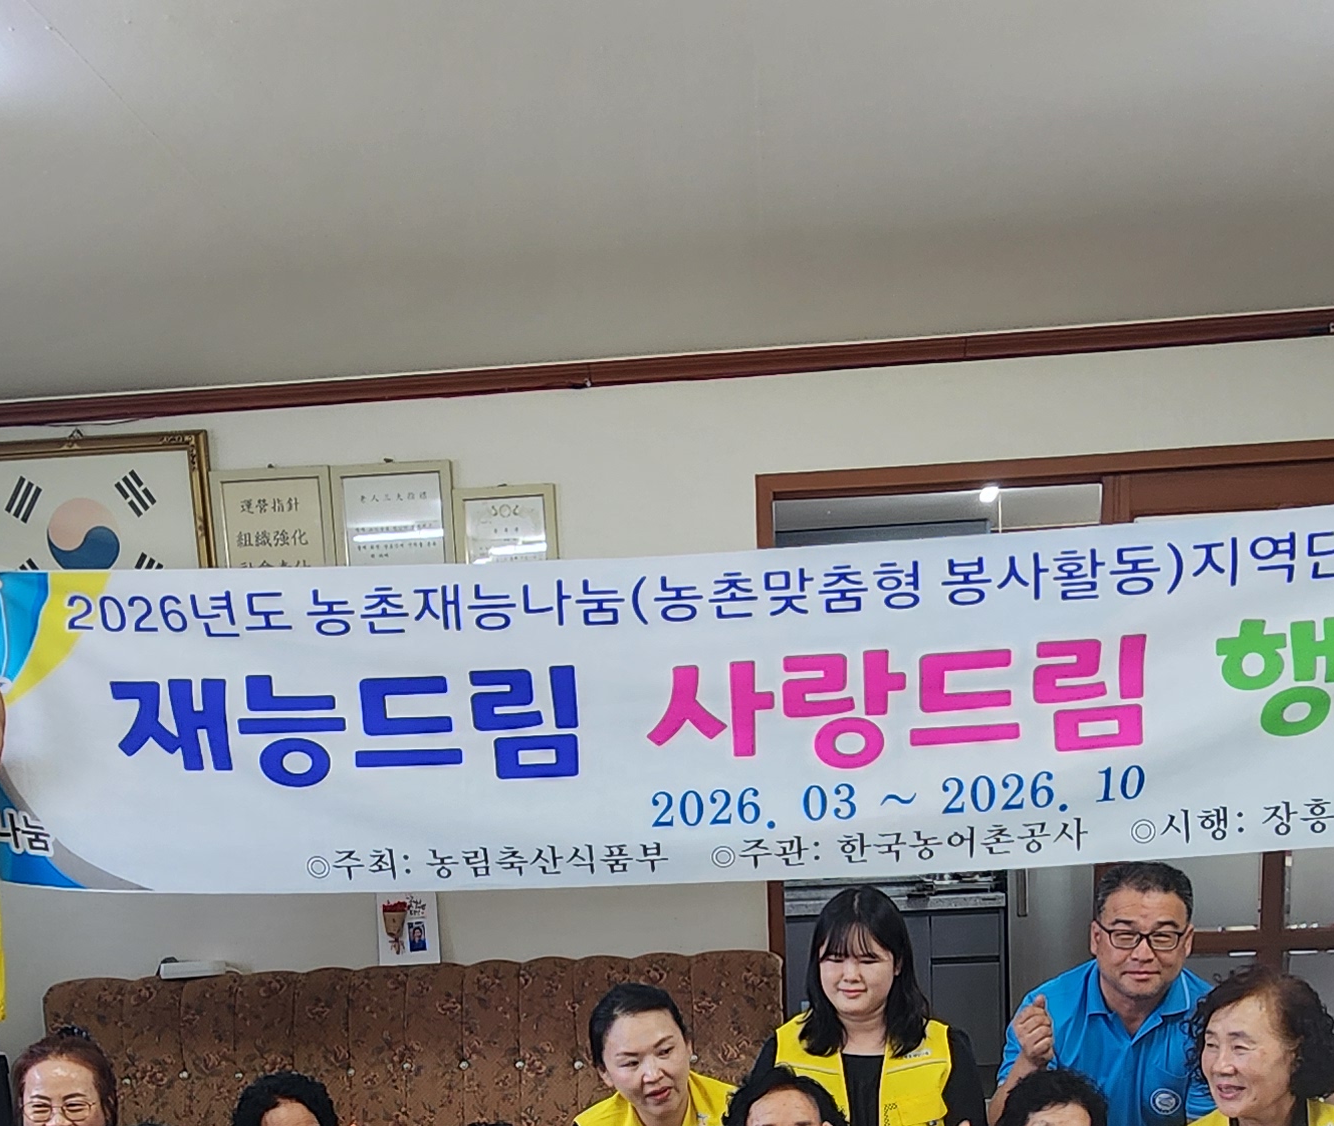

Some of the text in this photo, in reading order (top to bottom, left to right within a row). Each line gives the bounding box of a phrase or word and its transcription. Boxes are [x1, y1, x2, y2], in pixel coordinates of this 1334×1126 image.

[66, 588, 293, 638] 2026년도
[305, 558, 921, 637] 농촌재능나눔(농촌맞춤형
[110, 664, 579, 788] 재능드림
[647, 633, 1147, 769] 사랑드림
[651, 788, 776, 830] 2026.
[803, 783, 858, 822] 03
[940, 771, 1069, 814] 2026.
[1097, 765, 1146, 804] 10
[425, 841, 669, 877] 농림축산식품부
[836, 817, 1088, 864] 한국농어촌공사
